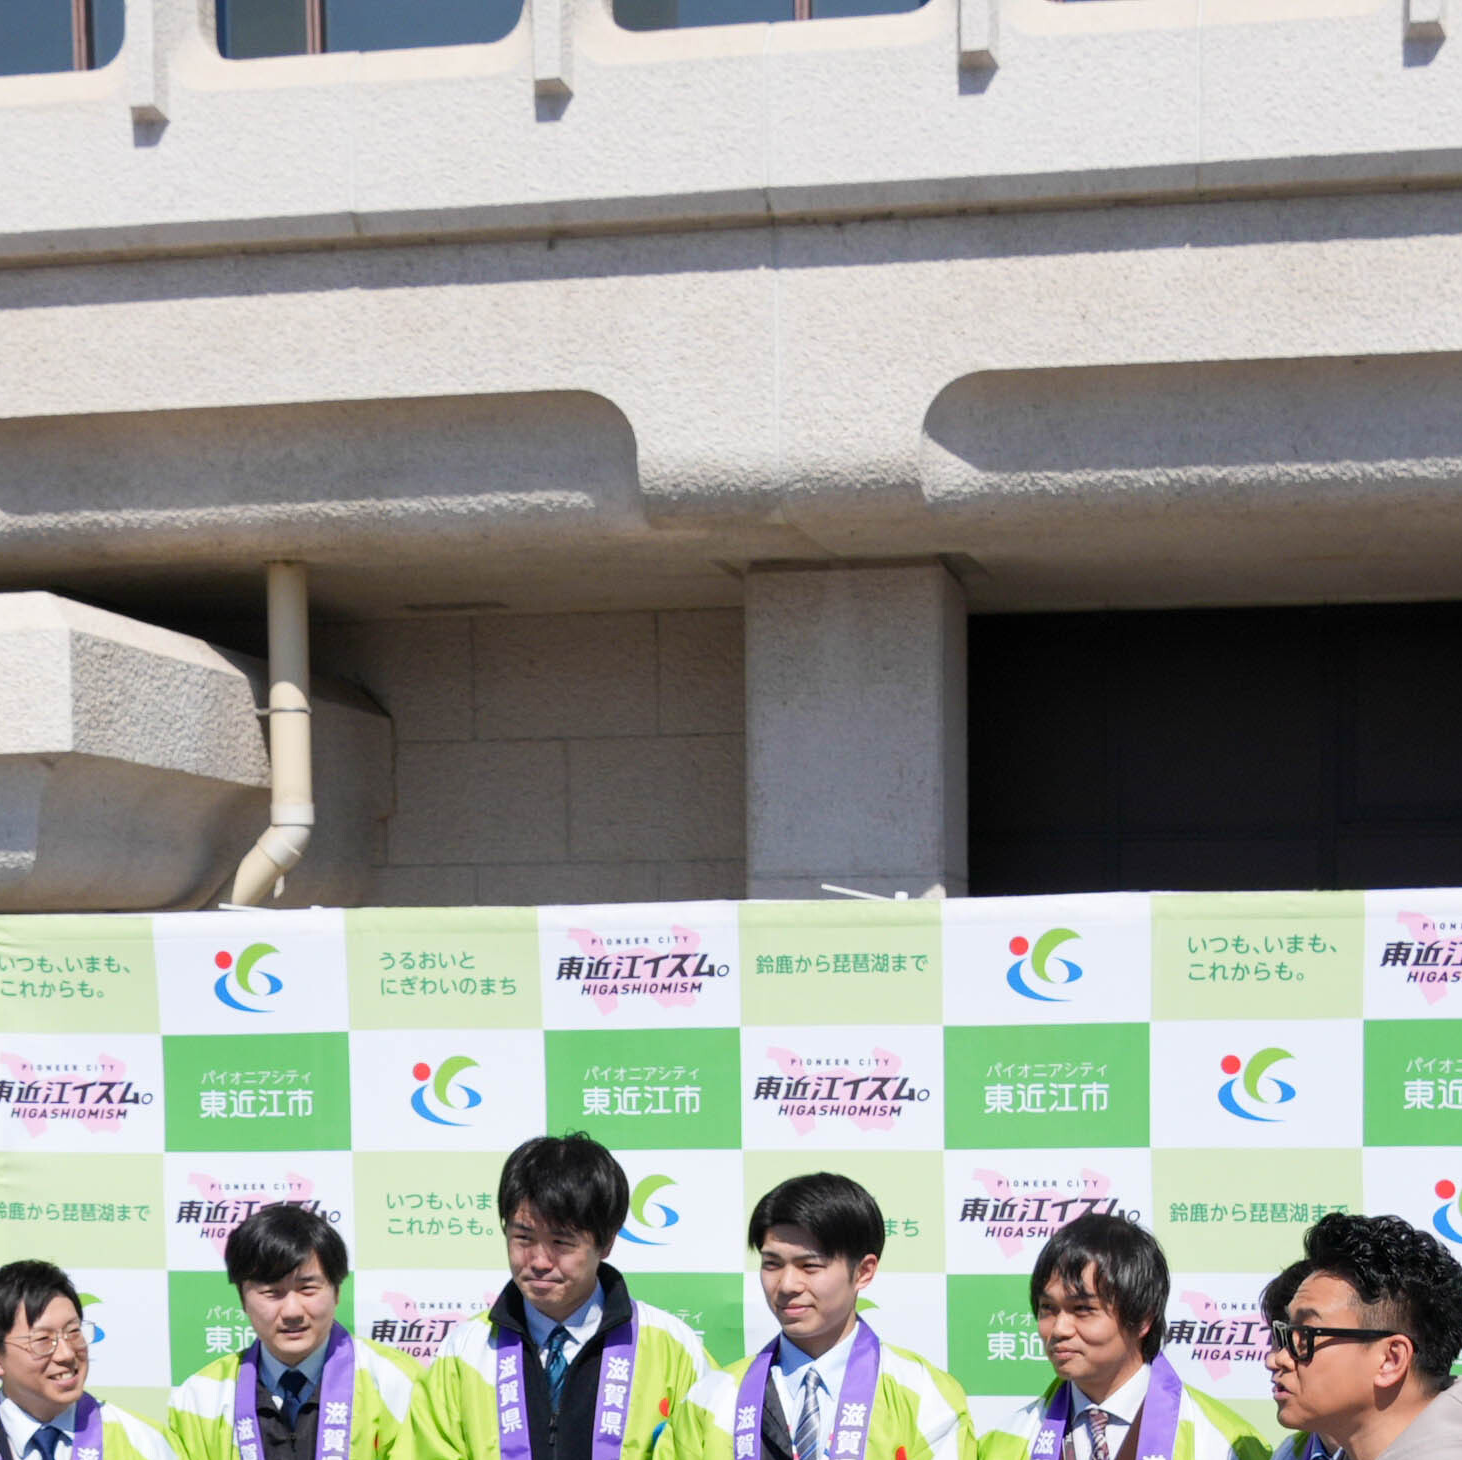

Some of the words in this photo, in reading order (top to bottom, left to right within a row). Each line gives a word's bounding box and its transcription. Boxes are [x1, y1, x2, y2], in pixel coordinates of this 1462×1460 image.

[591, 937, 650, 945] PIONEER
[658, 936, 690, 944] CITY
[1187, 934, 1338, 954] いつも、いまも、
[379, 952, 476, 971] うるおいと
[755, 953, 929, 975] 鈴鹿から琵琶湖まで
[1188, 961, 1305, 982] これからも。
[0, 980, 105, 999] これからも。
[380, 976, 517, 996] にぎわいのまち
[581, 982, 703, 996] HIGASHIOMISM
[22, 1064, 79, 1072] PIONEER
[87, 1064, 115, 1072] CITY
[791, 1058, 850, 1067] PIONEER
[859, 1058, 890, 1067] CITY
[986, 1062, 1108, 1078] パイオニアシティ
[201, 1070, 312, 1086] パイオニアシティ
[584, 1066, 700, 1081] パイオニアシティ
[199, 1089, 315, 1119] 東近江市
[582, 1085, 702, 1116] 東近江市
[984, 1082, 1111, 1114] 東近江市
[11, 1107, 128, 1120] HIGASHIOMISM
[778, 1104, 902, 1117] HIGASHIOMISM
[210, 1183, 266, 1191] PIONEER
[274, 1183, 302, 1191] CITY
[997, 1179, 1058, 1188] PIONEER
[1067, 1179, 1099, 1188] CITY
[387, 1217, 494, 1236] これからも。
[404, 1302, 463, 1310] PIONEER
[498, 1354, 523, 1434] 滋賀県
[599, 1356, 630, 1437] 滋賀県
